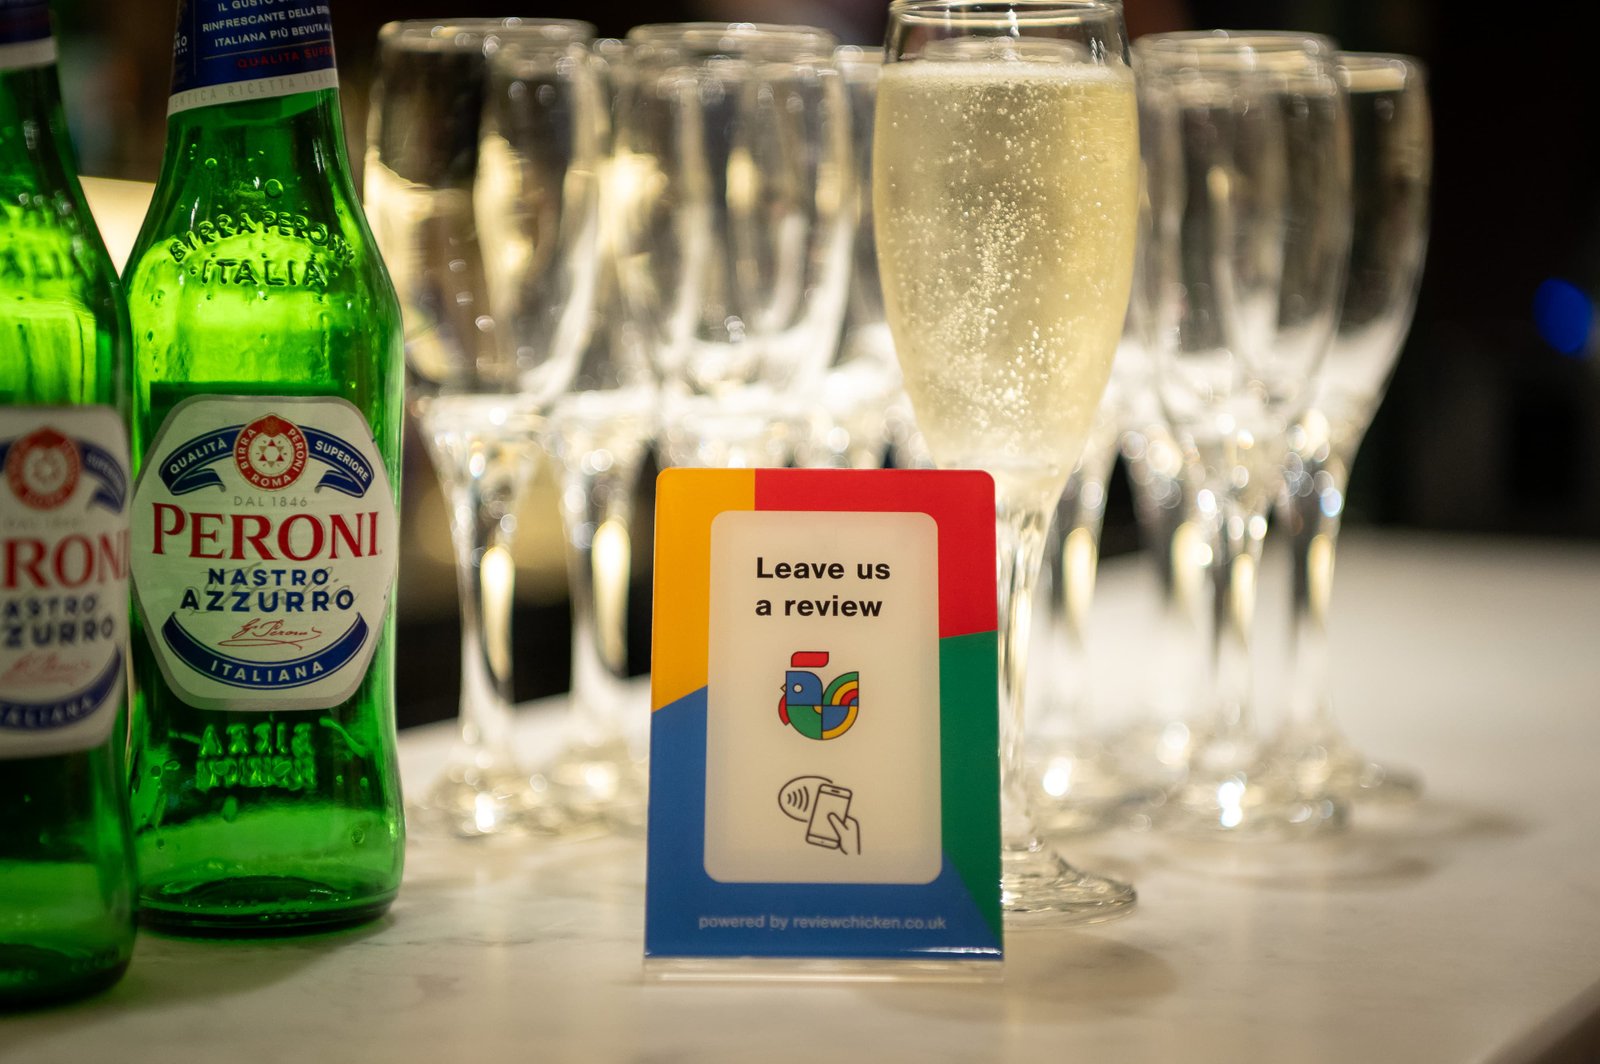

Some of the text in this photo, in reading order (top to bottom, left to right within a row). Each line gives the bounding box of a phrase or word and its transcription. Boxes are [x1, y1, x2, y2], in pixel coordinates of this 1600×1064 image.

[202, 10, 286, 32] RINFRESCANTE
[288, 7, 316, 19] DELLA
[217, 3, 228, 12] IL
[214, 32, 267, 47] ITALIANA
[270, 26, 289, 39] PIÙ
[291, 23, 323, 36] BEVUTA
[201, 257, 329, 287] ITALIA
[169, 438, 228, 475] QUALITÀ
[238, 427, 306, 473] BIRRA PERONI
[315, 439, 368, 482] SUPERIORE
[251, 473, 292, 488] ROMA
[233, 495, 308, 507] DAL 1846
[151, 502, 379, 561] PERONI
[207, 568, 329, 586] NASTRO
[756, 556, 891, 580] Leave us
[180, 589, 354, 613] AZZURRO
[755, 594, 883, 617] a review
[210, 659, 324, 682] ITALIANA
[698, 914, 948, 932] powered by reviewchicken.co.uk
